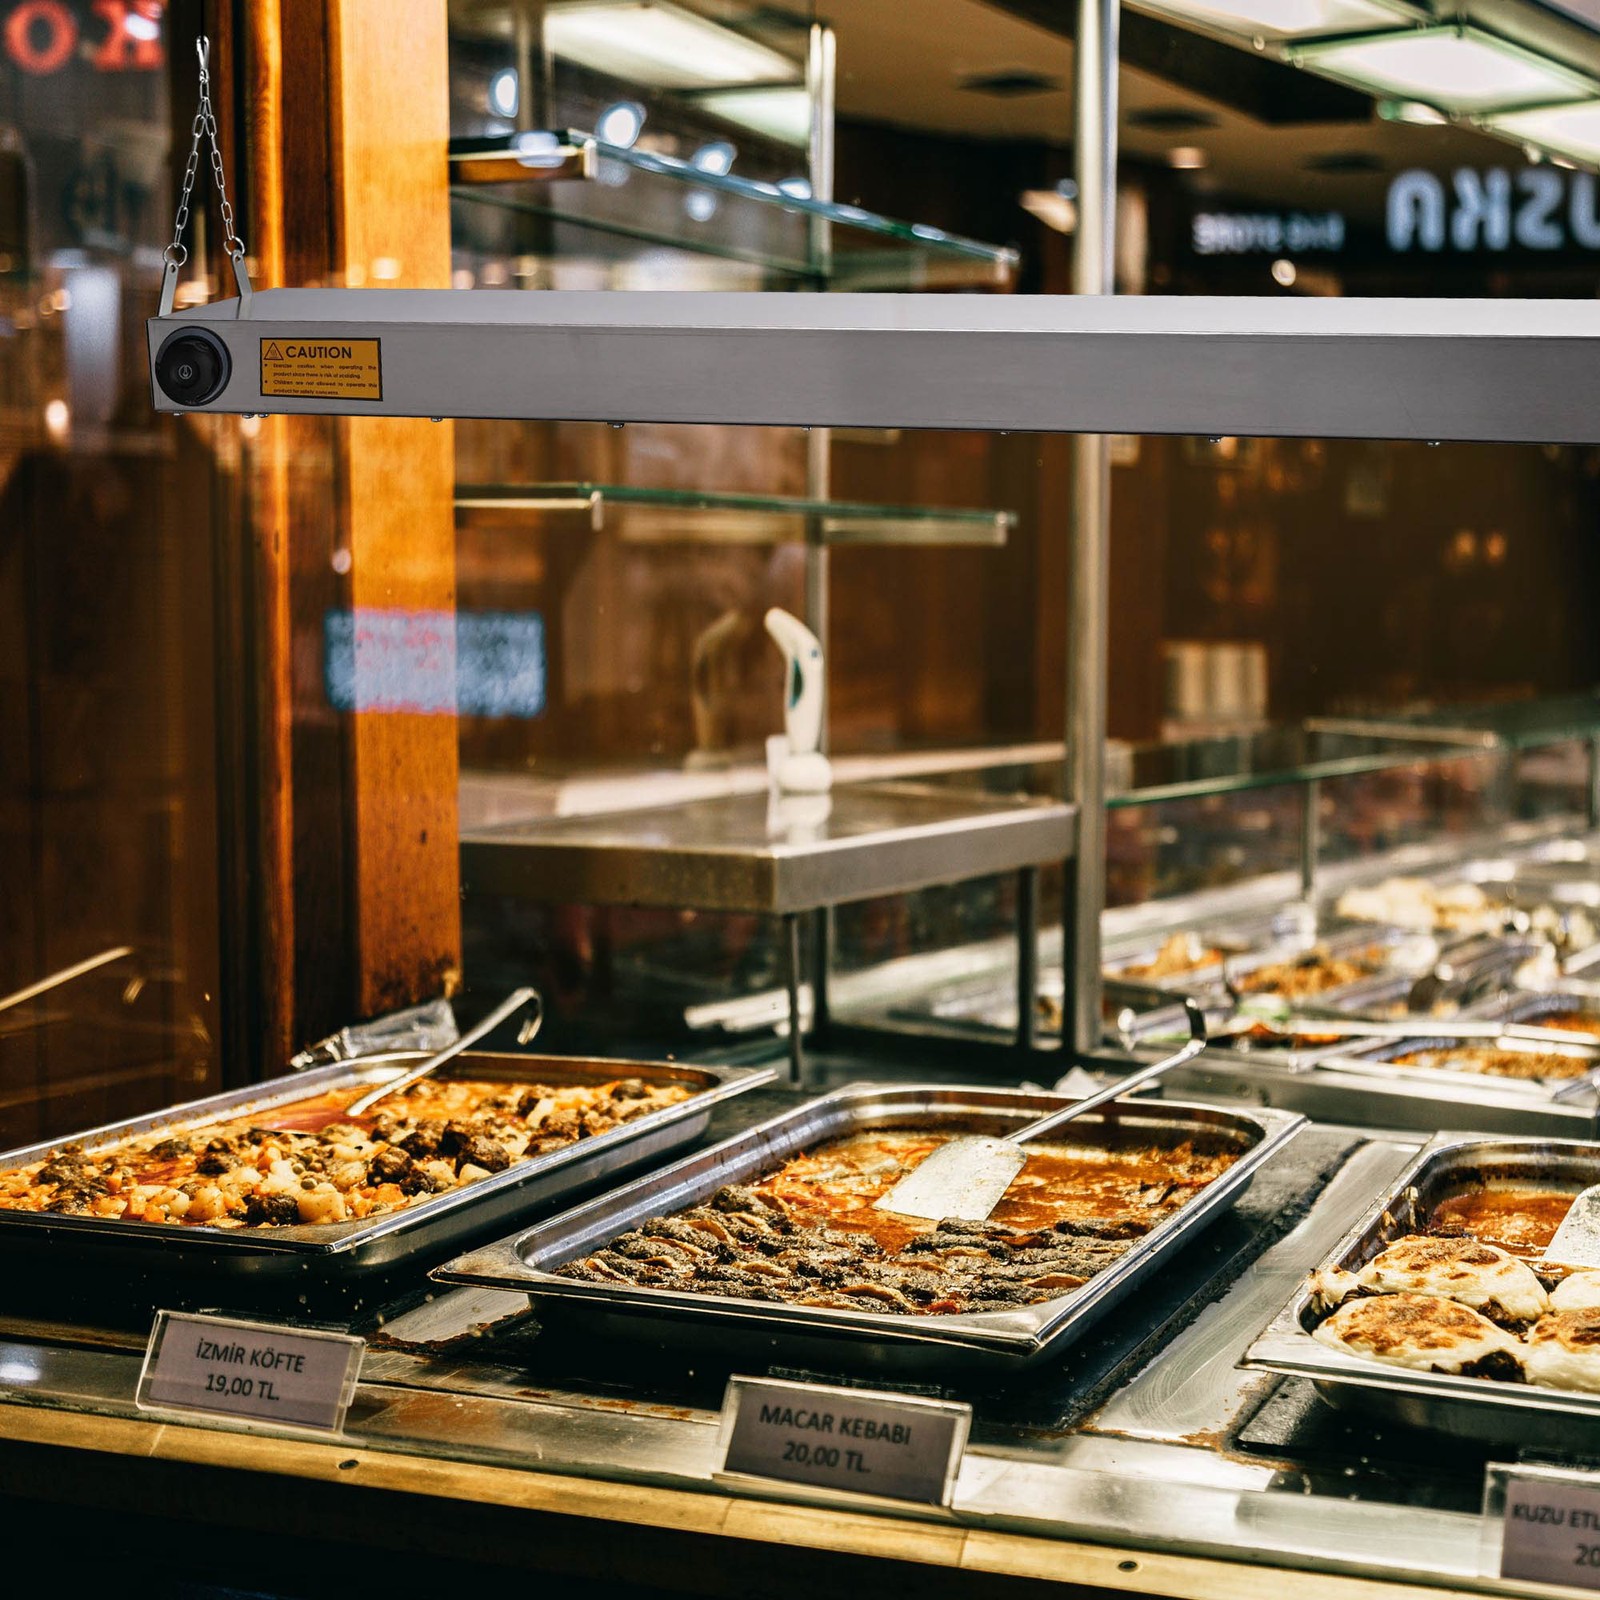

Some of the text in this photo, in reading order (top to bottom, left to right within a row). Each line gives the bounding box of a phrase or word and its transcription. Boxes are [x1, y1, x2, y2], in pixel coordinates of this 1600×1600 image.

[285, 345, 352, 359] CAUTION
[195, 1337, 306, 1374] İZMİR KÖFTE
[204, 1373, 280, 1401] 19,00 TL.
[758, 1403, 912, 1446] MACAR KEBABI
[781, 1440, 871, 1474] 20,00 TL.
[1511, 1503, 1565, 1526] KUZU
